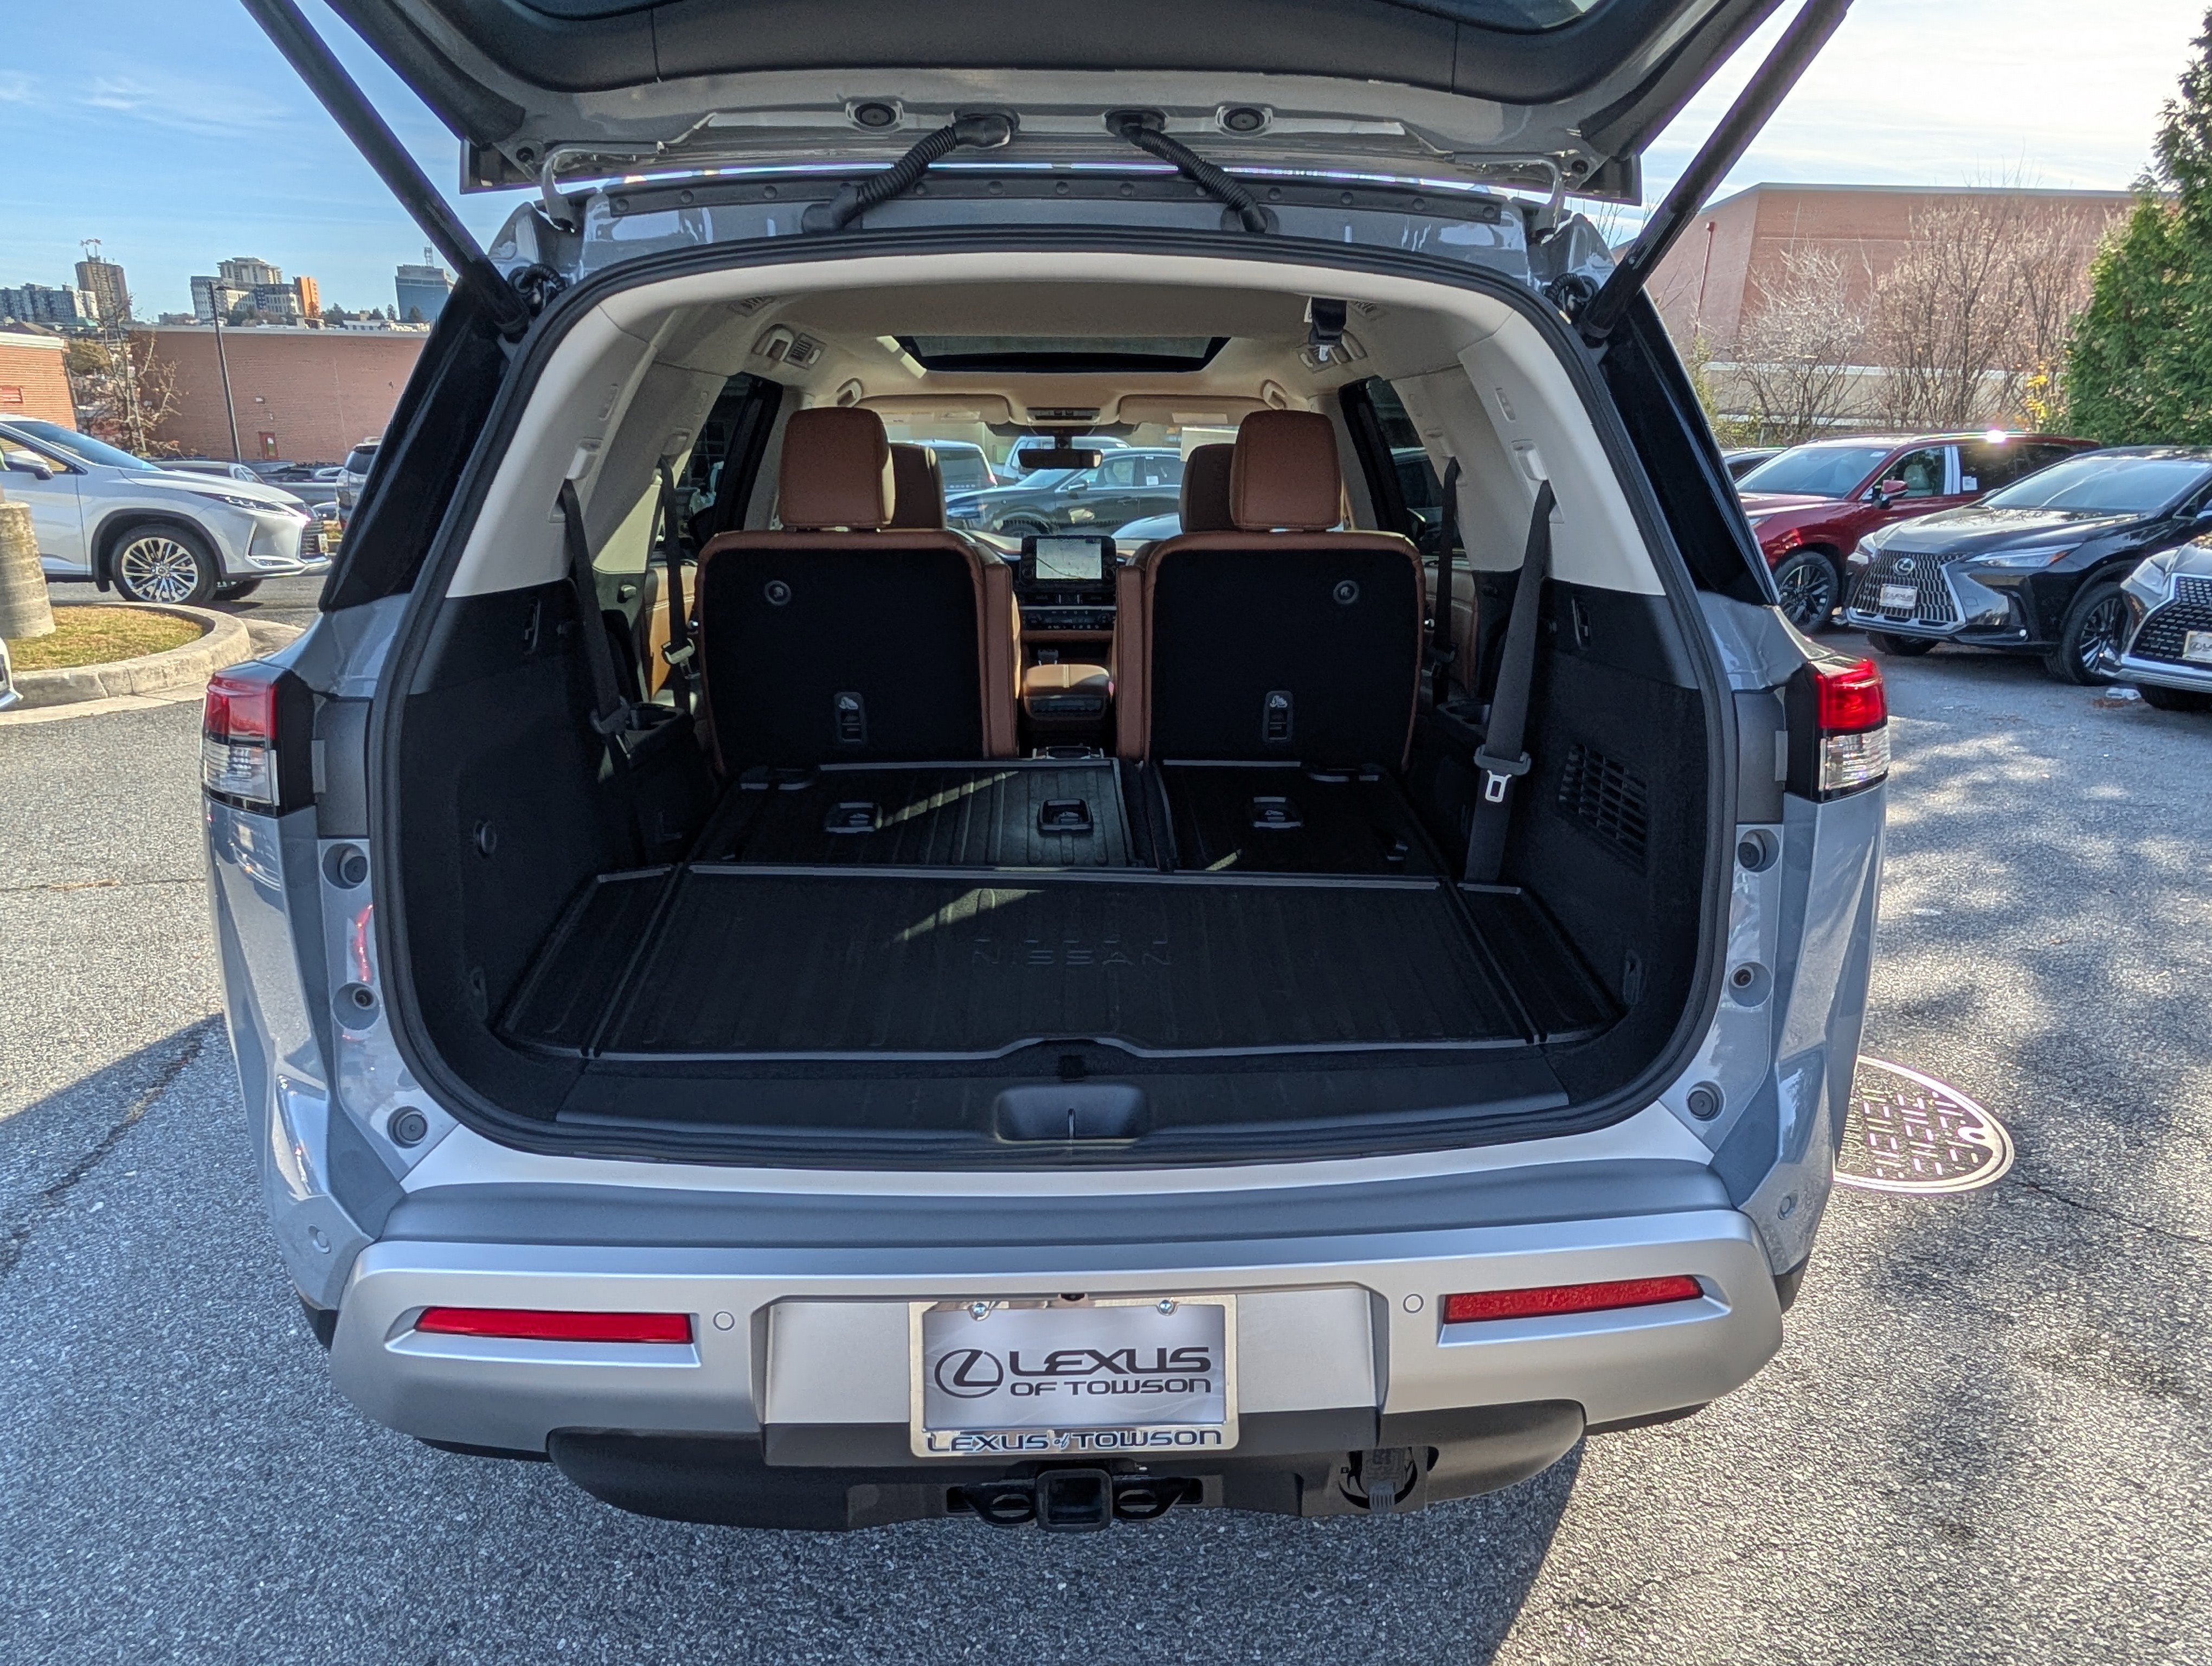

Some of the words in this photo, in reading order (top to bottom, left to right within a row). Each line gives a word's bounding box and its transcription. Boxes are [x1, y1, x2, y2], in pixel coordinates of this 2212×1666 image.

[1009, 1347, 1212, 1376] LEXUS
[1010, 1381, 1057, 1396] OF
[1064, 1378, 1212, 1395] TOWSON
[927, 1434, 1050, 1452] LEXUS
[1054, 1432, 1070, 1449] of
[1072, 1430, 1222, 1449] TOWSON
